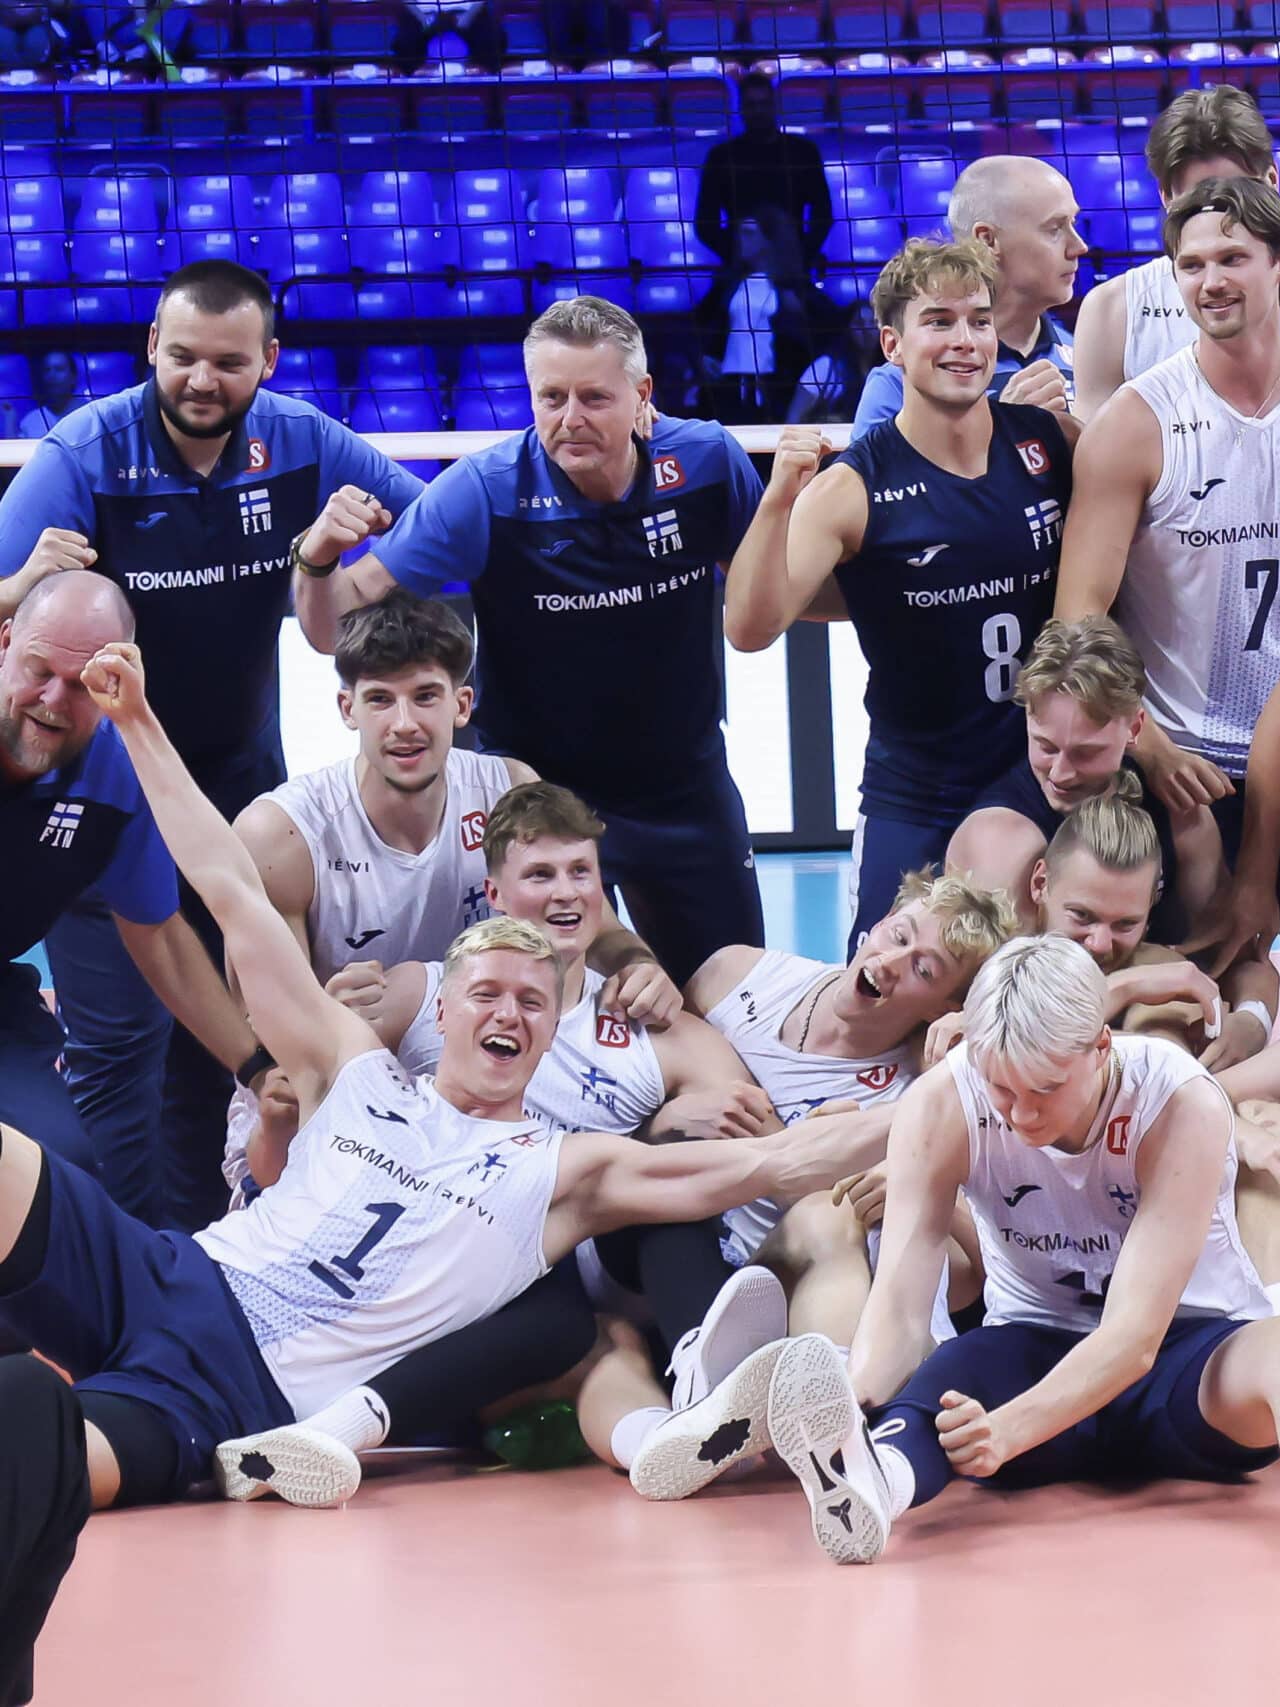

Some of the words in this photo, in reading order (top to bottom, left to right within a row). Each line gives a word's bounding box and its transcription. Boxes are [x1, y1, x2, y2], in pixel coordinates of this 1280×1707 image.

[874, 482, 927, 503] RÉVVI
[243, 512, 272, 535] FIN
[1176, 523, 1279, 548] TOKMANNI
[649, 533, 684, 558] FIN
[125, 566, 225, 591] TOKMANNI
[657, 566, 707, 595] RÉVVI
[903, 577, 1014, 607] TOKMANNI
[533, 585, 644, 612] TOKMANNI
[1243, 559, 1280, 650] 7
[982, 612, 1022, 703] 8
[40, 826, 75, 848] FIN
[598, 1020, 628, 1045] IS
[329, 1135, 429, 1193] TOKMANNI
[307, 1202, 407, 1300] 1
[1001, 1228, 1110, 1255] TOKMANNI
